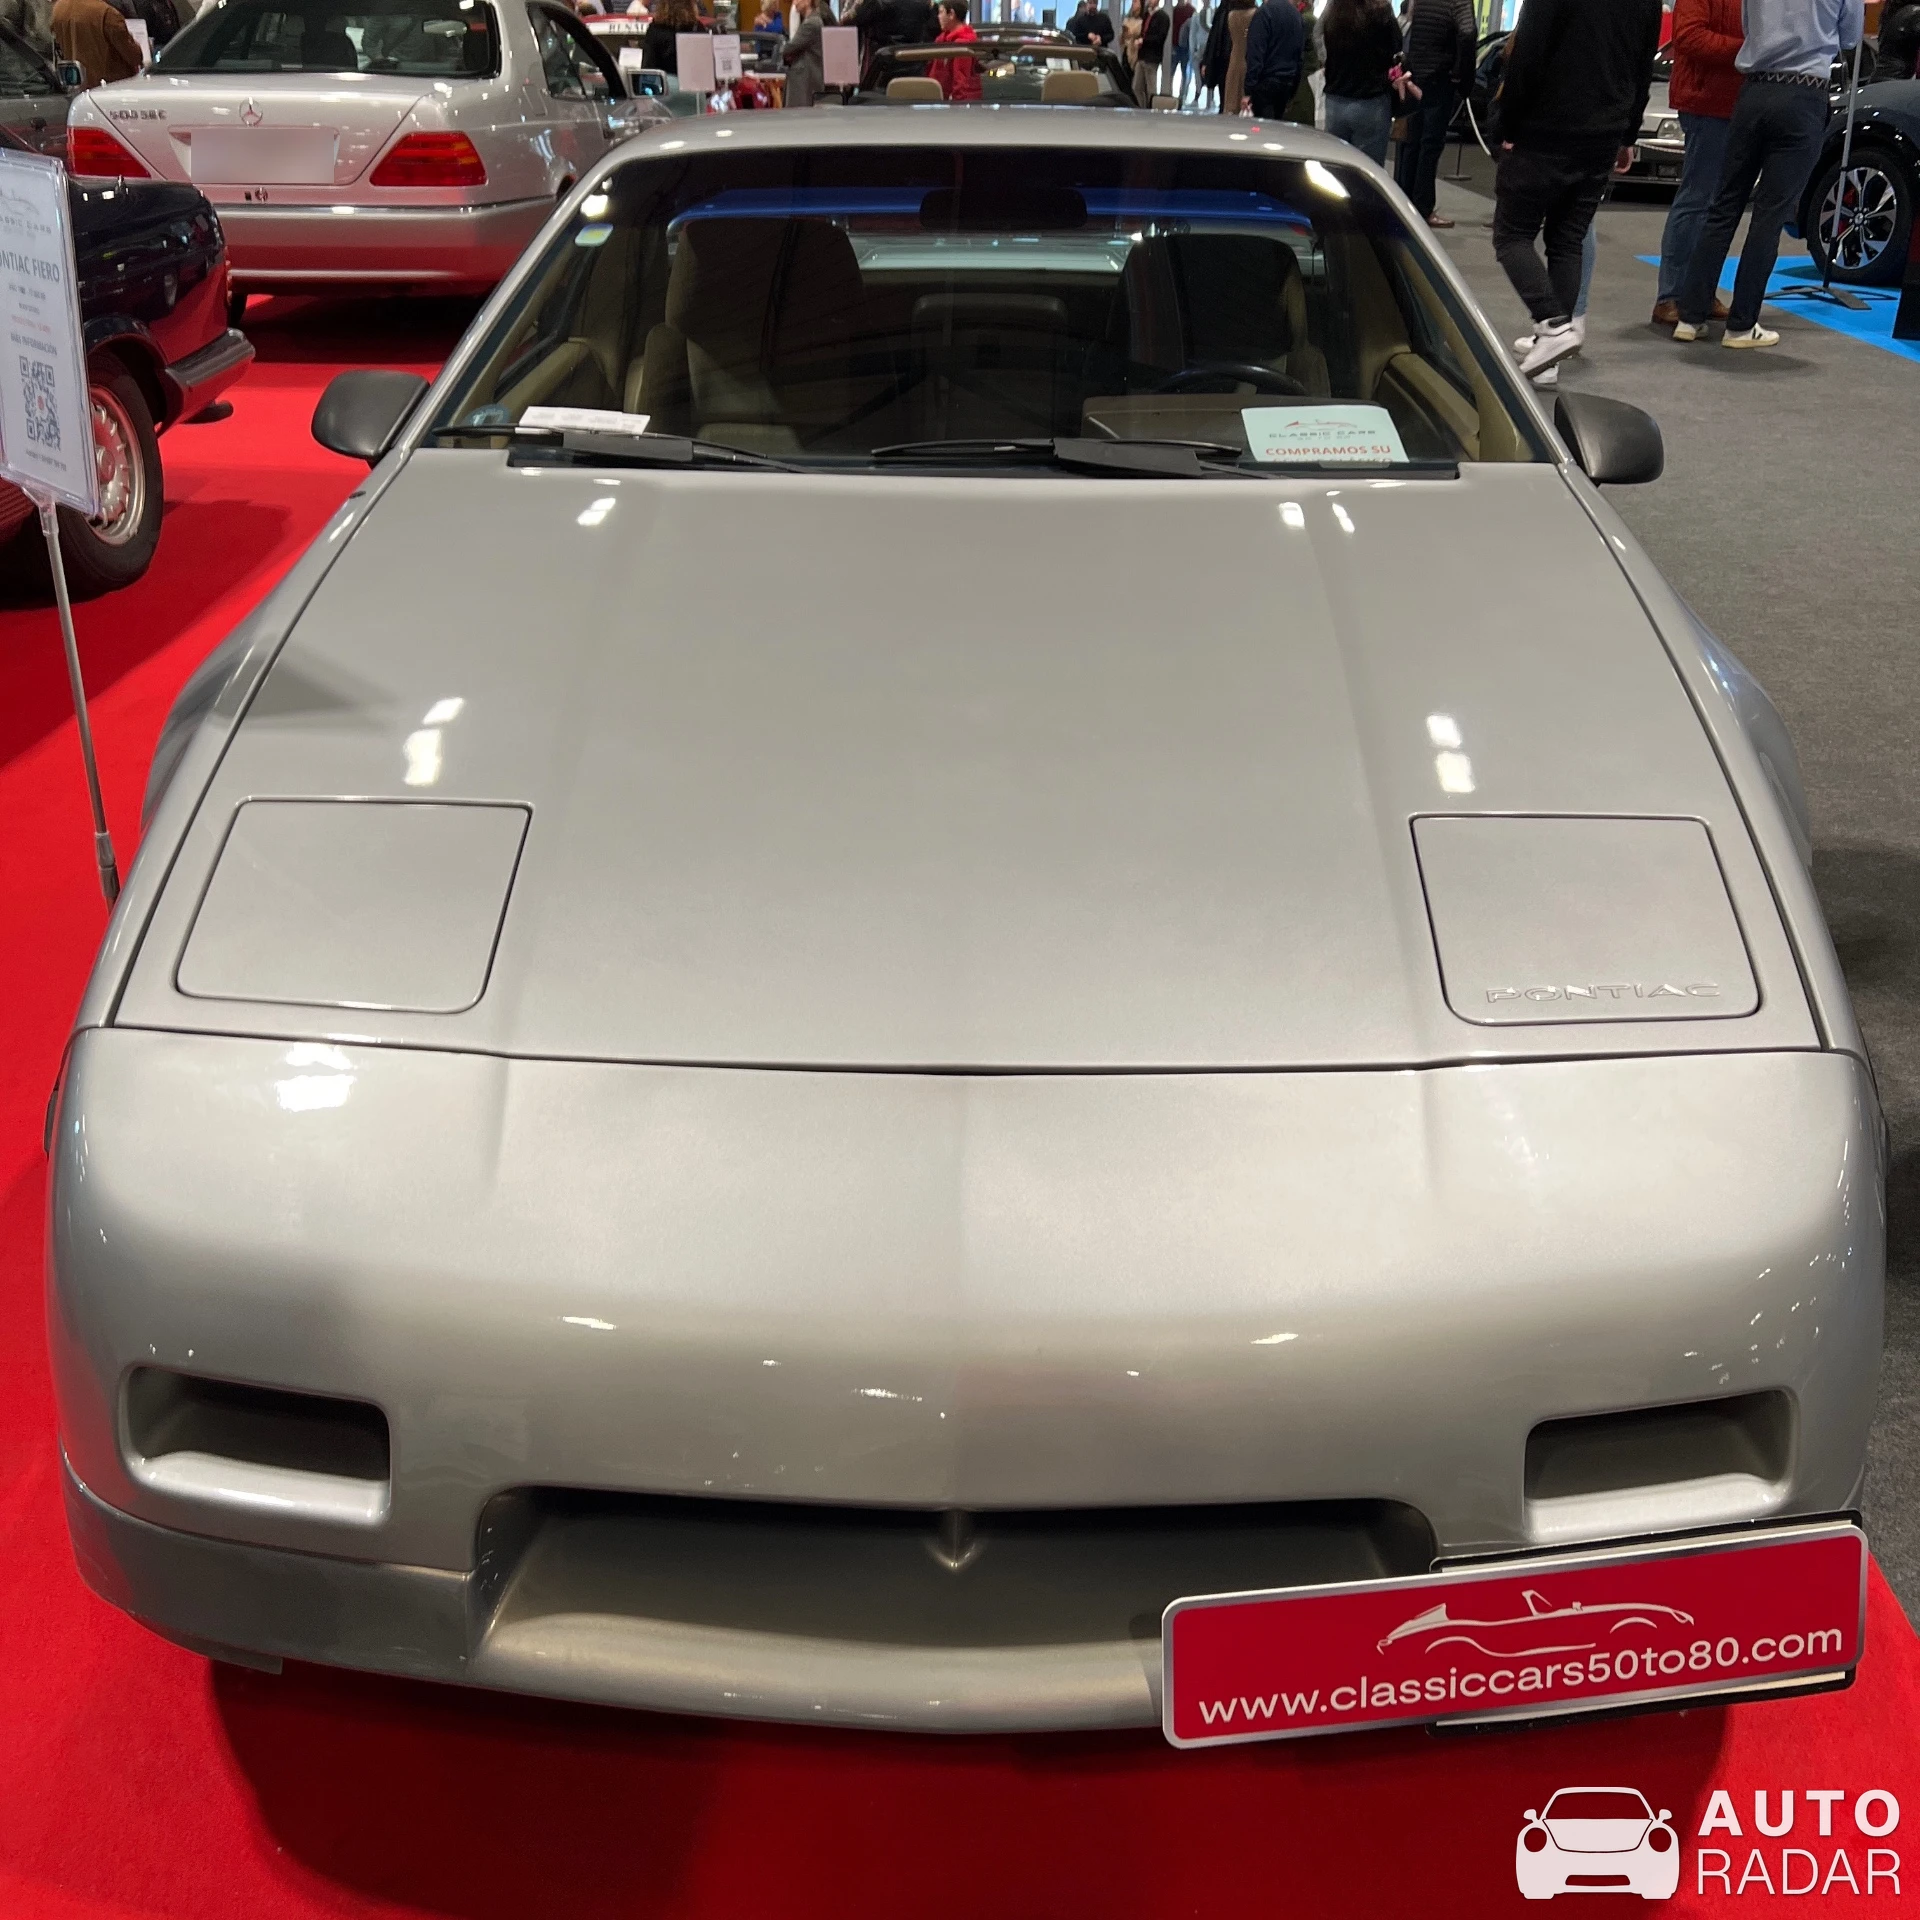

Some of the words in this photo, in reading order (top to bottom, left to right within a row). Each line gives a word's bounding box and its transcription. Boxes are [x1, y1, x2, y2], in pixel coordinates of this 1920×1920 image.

[32, 258, 60, 283] FIERO
[1266, 446, 1368, 456] COMPRAMOS
[1371, 445, 1391, 454] SU
[1486, 983, 1720, 1003] PONTIAC
[1199, 1627, 1843, 1725] www.classiccars50to80.com
